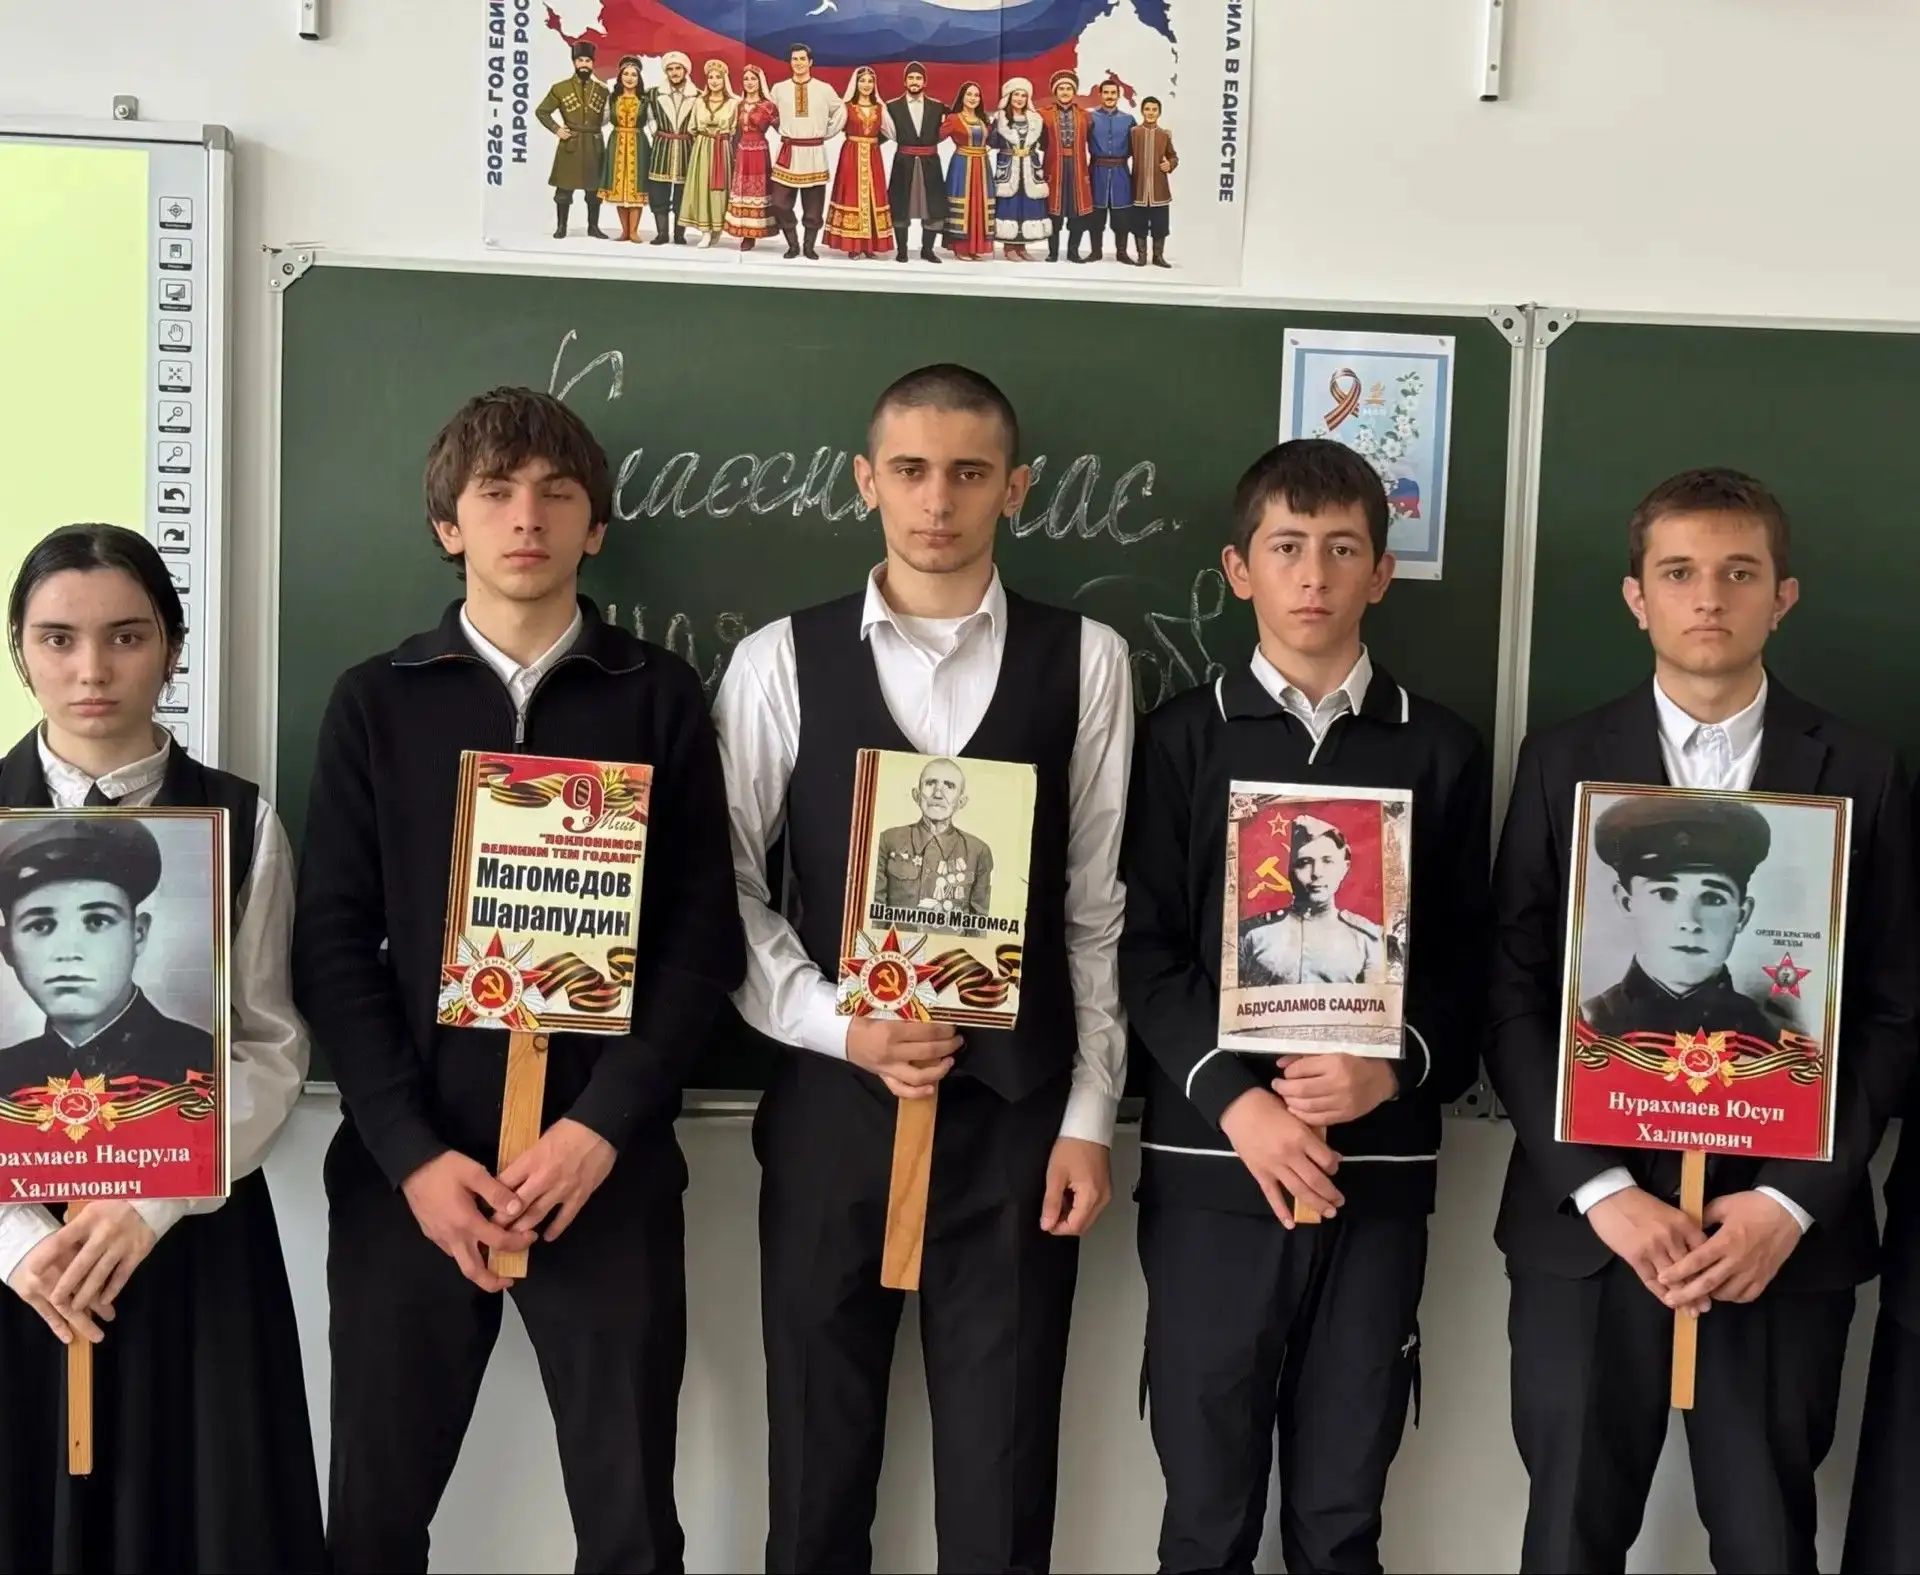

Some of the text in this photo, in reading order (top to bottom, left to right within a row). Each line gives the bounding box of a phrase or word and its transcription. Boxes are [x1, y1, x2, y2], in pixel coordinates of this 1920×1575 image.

[488, 0, 506, 49] ЕДИ
[488, 56, 505, 102] ГОД
[512, 0, 530, 164] НАРОДОВ РОС
[1219, 0, 1243, 203] ИЛА В ЕДИНСТВЕ
[487, 124, 503, 186] 2026
[561, 773, 605, 834] 9
[480, 842, 549, 858] ВЕЛИКИМ
[552, 848, 580, 860] ТЕМ
[475, 856, 632, 900] Магомедов
[470, 895, 632, 939] Шарапудин
[869, 903, 1020, 935] Шамилов Магомед
[1236, 998, 1386, 1017] АБДУСАЛАМОВ СААДУЛА
[1608, 1091, 1785, 1126] Нурахмаев Юсуп
[95, 1144, 191, 1169] Насрула
[1636, 1122, 1753, 1149] Халимович
[9, 1177, 142, 1198] Халимович
